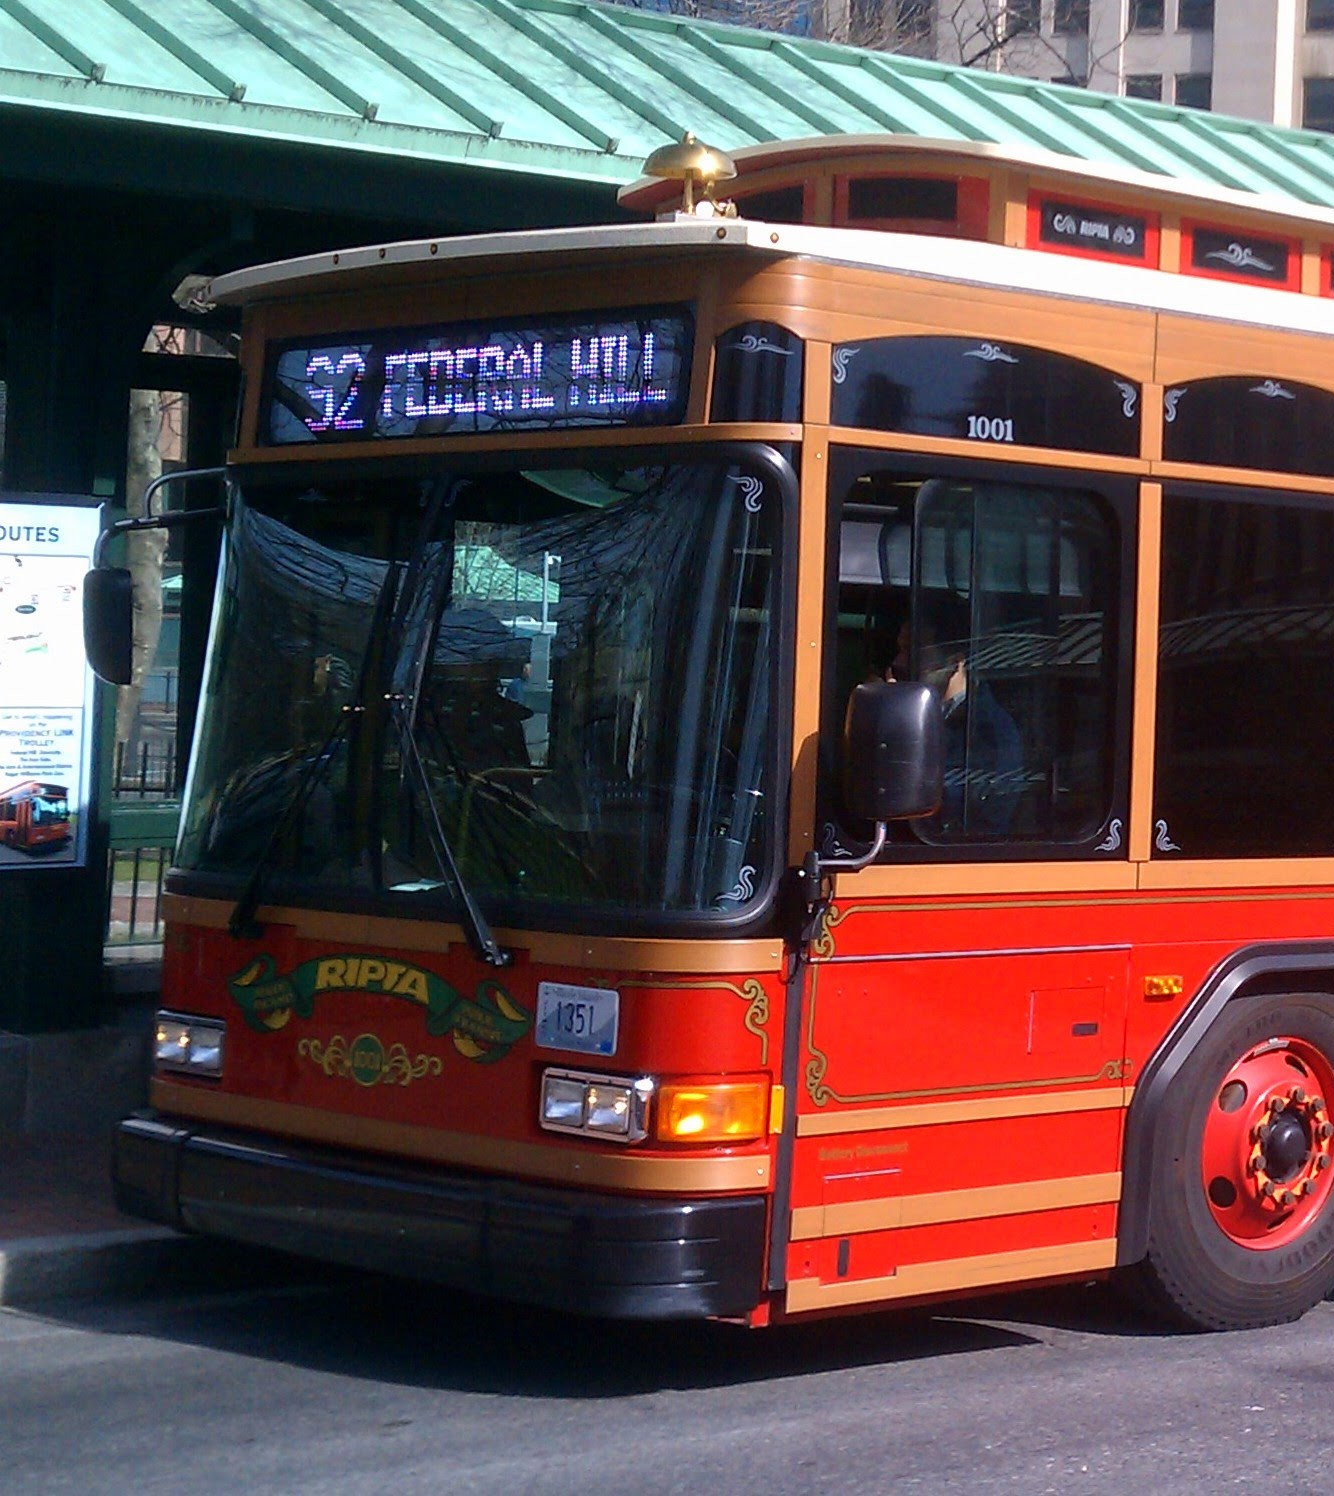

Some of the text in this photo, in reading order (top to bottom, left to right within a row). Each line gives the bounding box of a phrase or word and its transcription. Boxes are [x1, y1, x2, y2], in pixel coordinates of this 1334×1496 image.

[383, 342, 555, 417] FEDERAL
[570, 333, 667, 405] HILL
[967, 415, 1014, 442] 1001
[315, 958, 430, 1005] RIPTA
[557, 1001, 595, 1036] 1351
